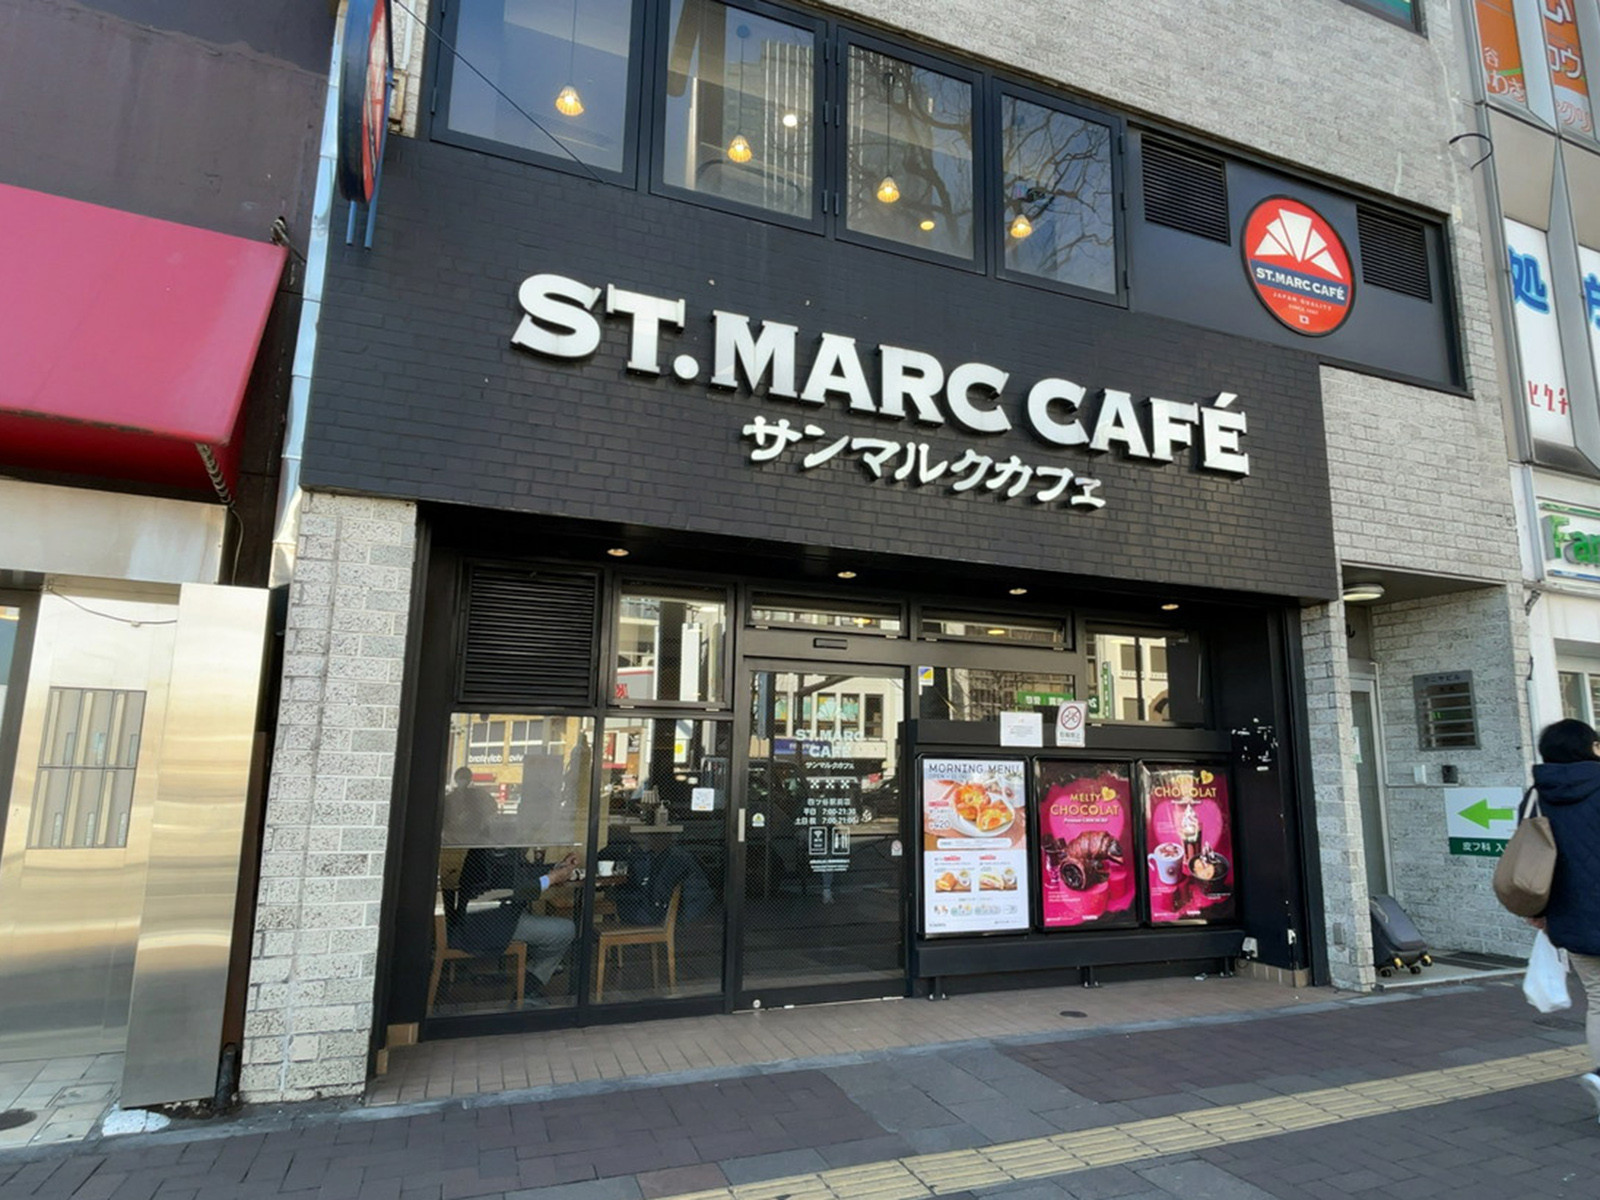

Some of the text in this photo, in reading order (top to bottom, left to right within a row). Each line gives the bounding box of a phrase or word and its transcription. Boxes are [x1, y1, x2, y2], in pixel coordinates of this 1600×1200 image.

[1256, 267, 1345, 301] ST.MARC CAFÉ
[511, 273, 1250, 477] ST.MARC CAFÉ
[742, 415, 1107, 509] サンマルクカフェ
[805, 761, 856, 770] サンマルクカフェ
[929, 763, 1020, 775] MORNING MENU
[1069, 793, 1102, 802] MELTY
[1050, 804, 1120, 815] CHOCOLAT
[1495, 843, 1508, 853] 入
